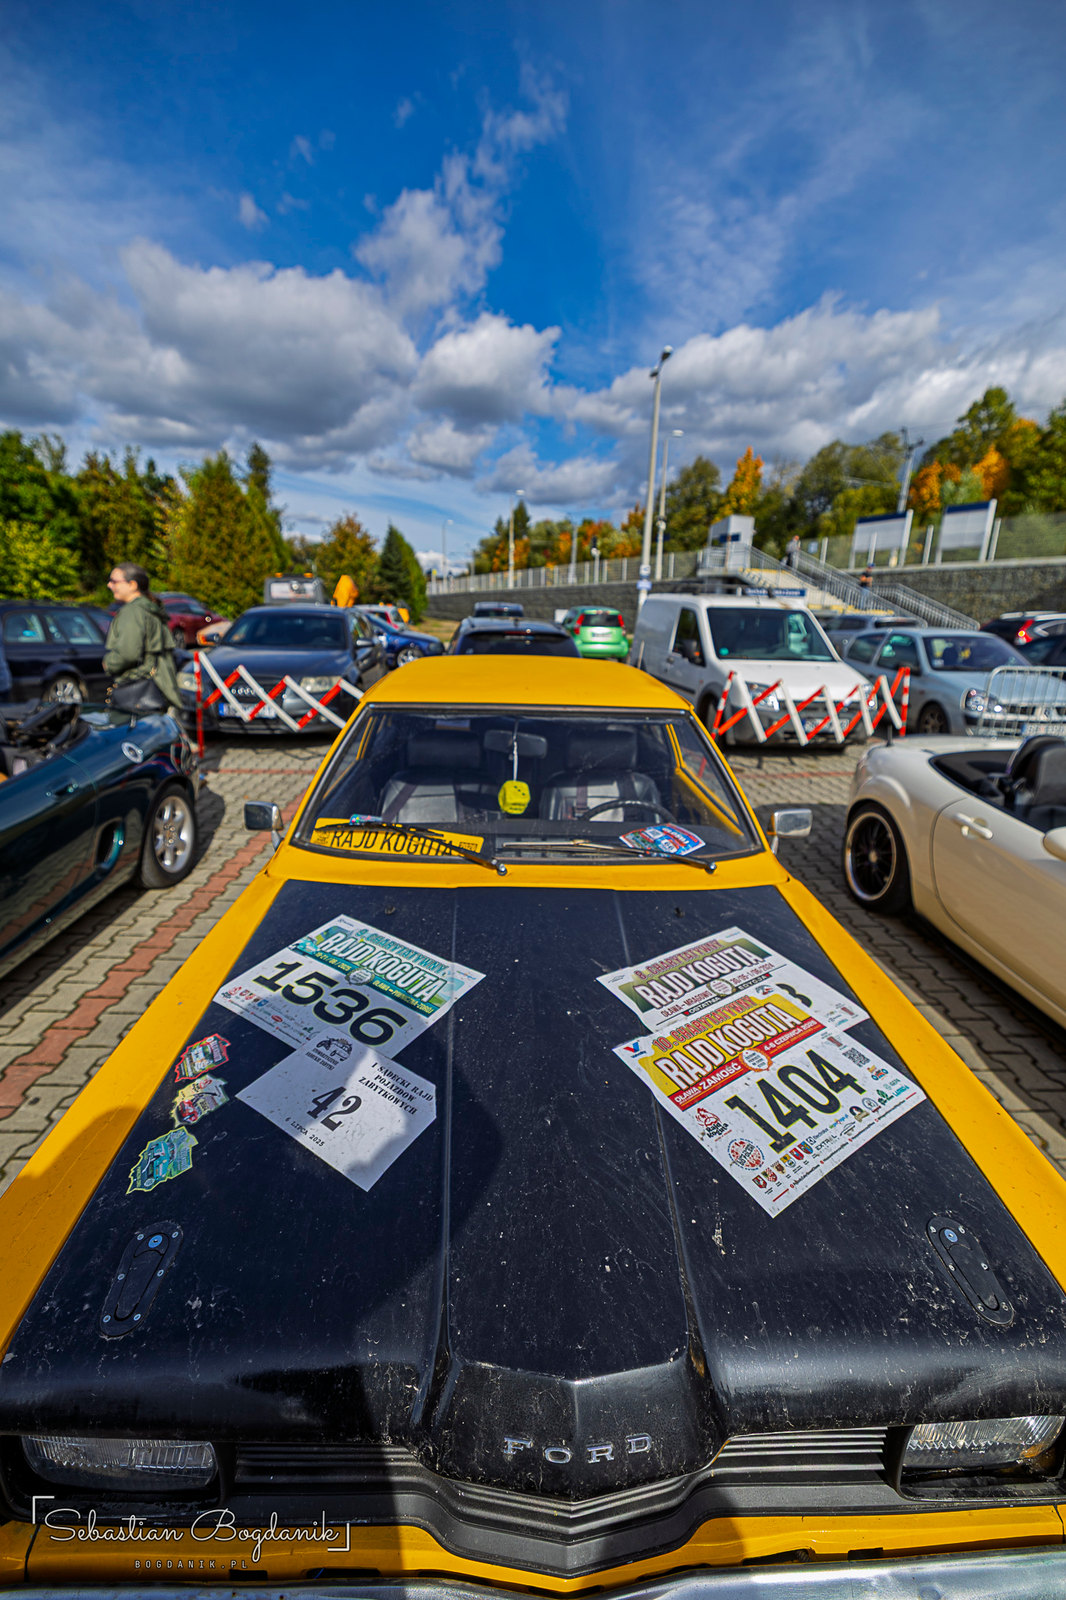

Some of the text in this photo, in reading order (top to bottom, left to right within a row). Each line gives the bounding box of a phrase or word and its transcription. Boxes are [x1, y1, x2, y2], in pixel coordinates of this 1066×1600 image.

[331, 831, 377, 851] RAJD
[319, 932, 448, 1003] RAJD KOGUTA
[633, 970, 690, 1010] RAJD
[680, 945, 766, 984] KOGUTA
[253, 961, 408, 1046] 1536
[654, 1039, 726, 1091] RAJD
[707, 1002, 804, 1057] KOGUTA
[358, 1076, 418, 1115] ZABYTKOWYCH
[377, 1065, 411, 1088] SĄDECKI
[411, 1085, 434, 1102] RAJD
[700, 1061, 742, 1091] ZAMOŚĆ
[307, 1086, 362, 1132] 42
[724, 1050, 866, 1154] 1404
[290, 1121, 309, 1136] LIPCA
[308, 1134, 325, 1147] 2025
[503, 1433, 652, 1464] FORD
